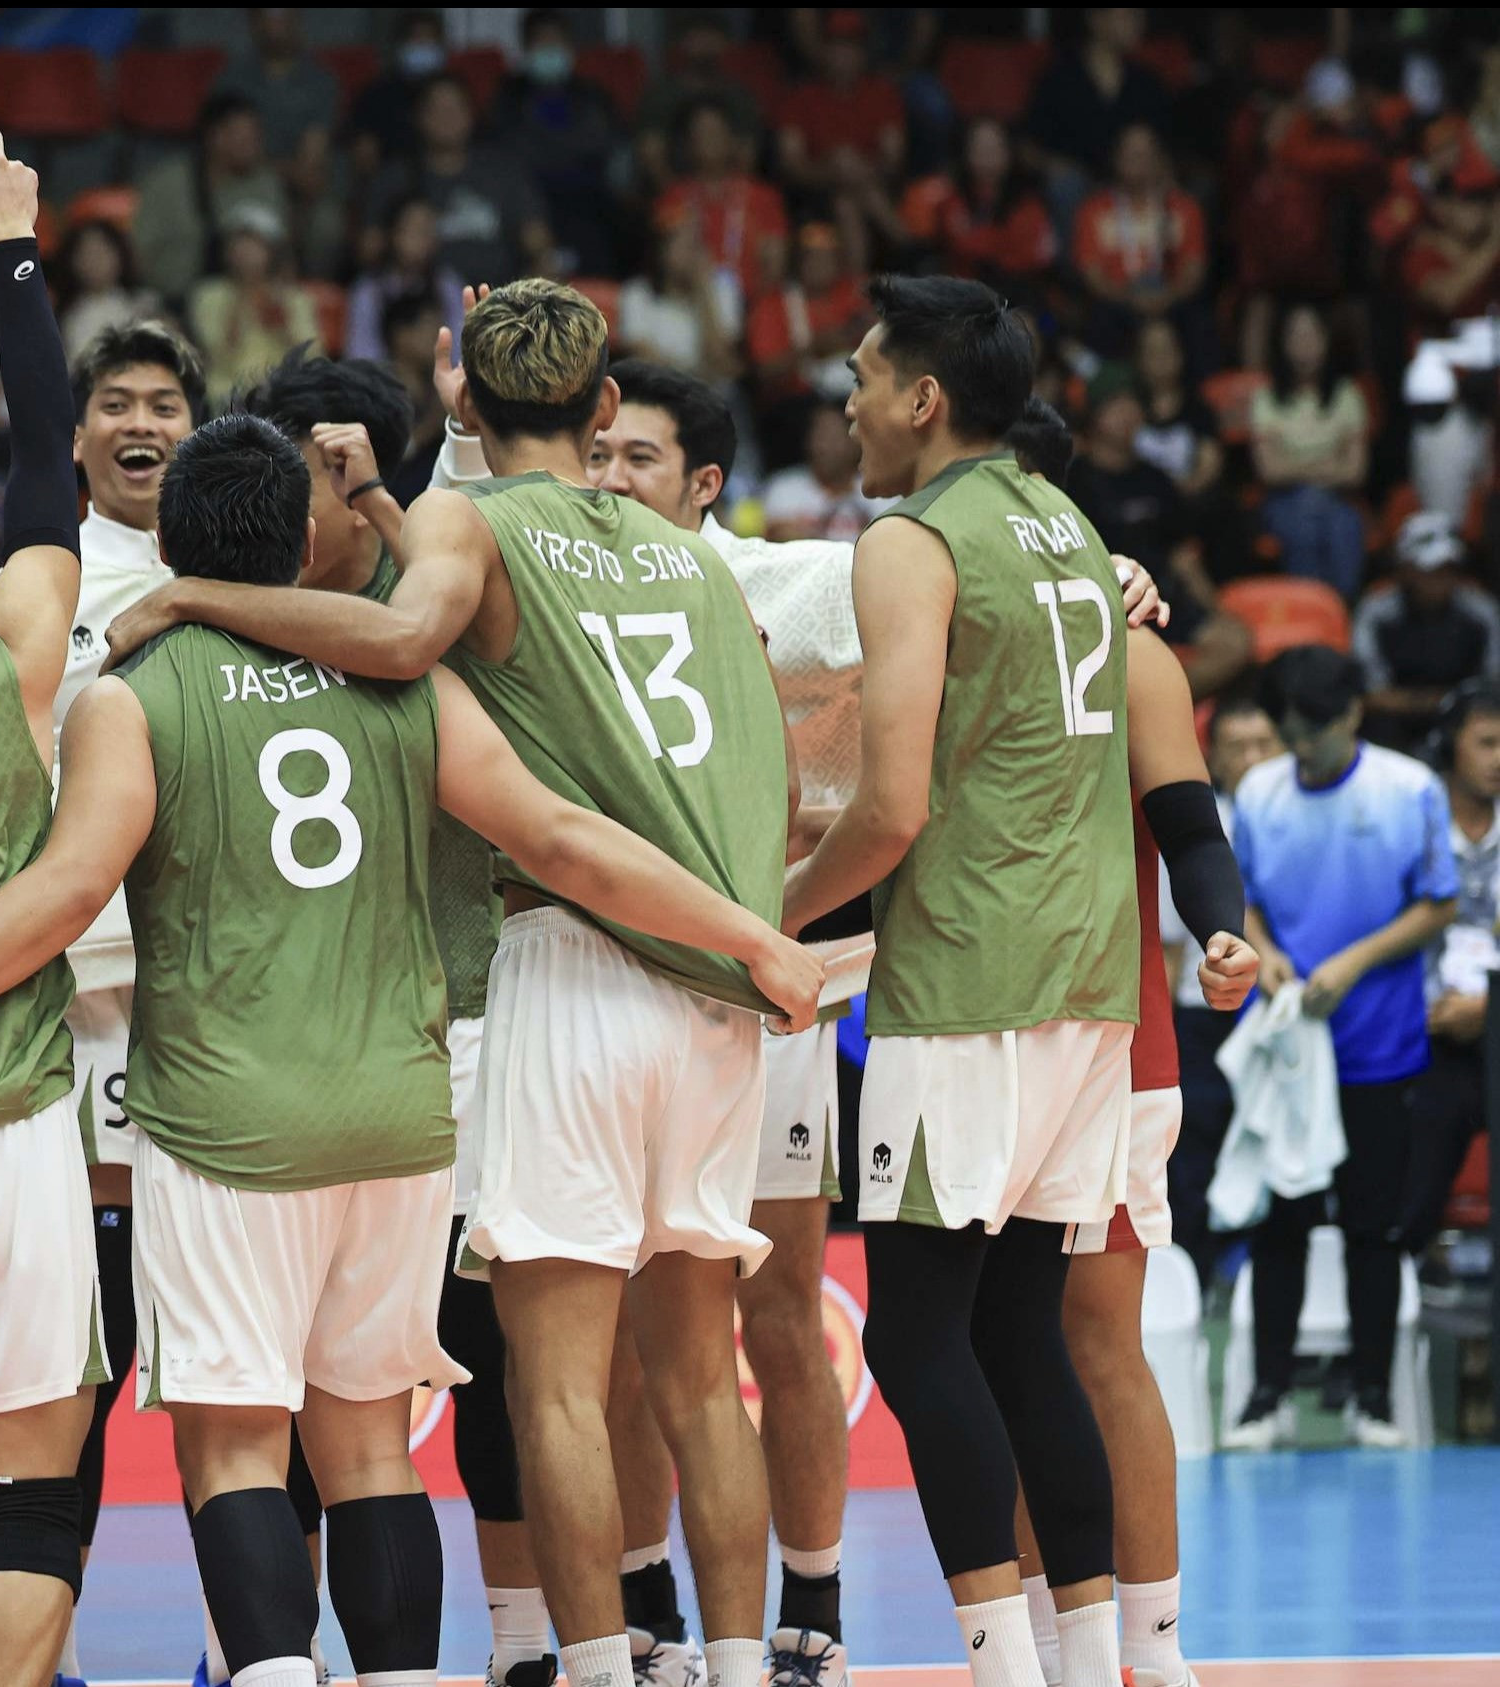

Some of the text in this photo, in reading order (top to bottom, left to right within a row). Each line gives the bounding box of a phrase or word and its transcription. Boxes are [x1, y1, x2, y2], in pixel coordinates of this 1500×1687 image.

[632, 543, 705, 583] SINA
[220, 657, 347, 703] JASEN
[578, 611, 714, 768] 13
[1033, 577, 1114, 736] 12
[257, 728, 363, 889] 8
[870, 1173, 893, 1183] MILLS
